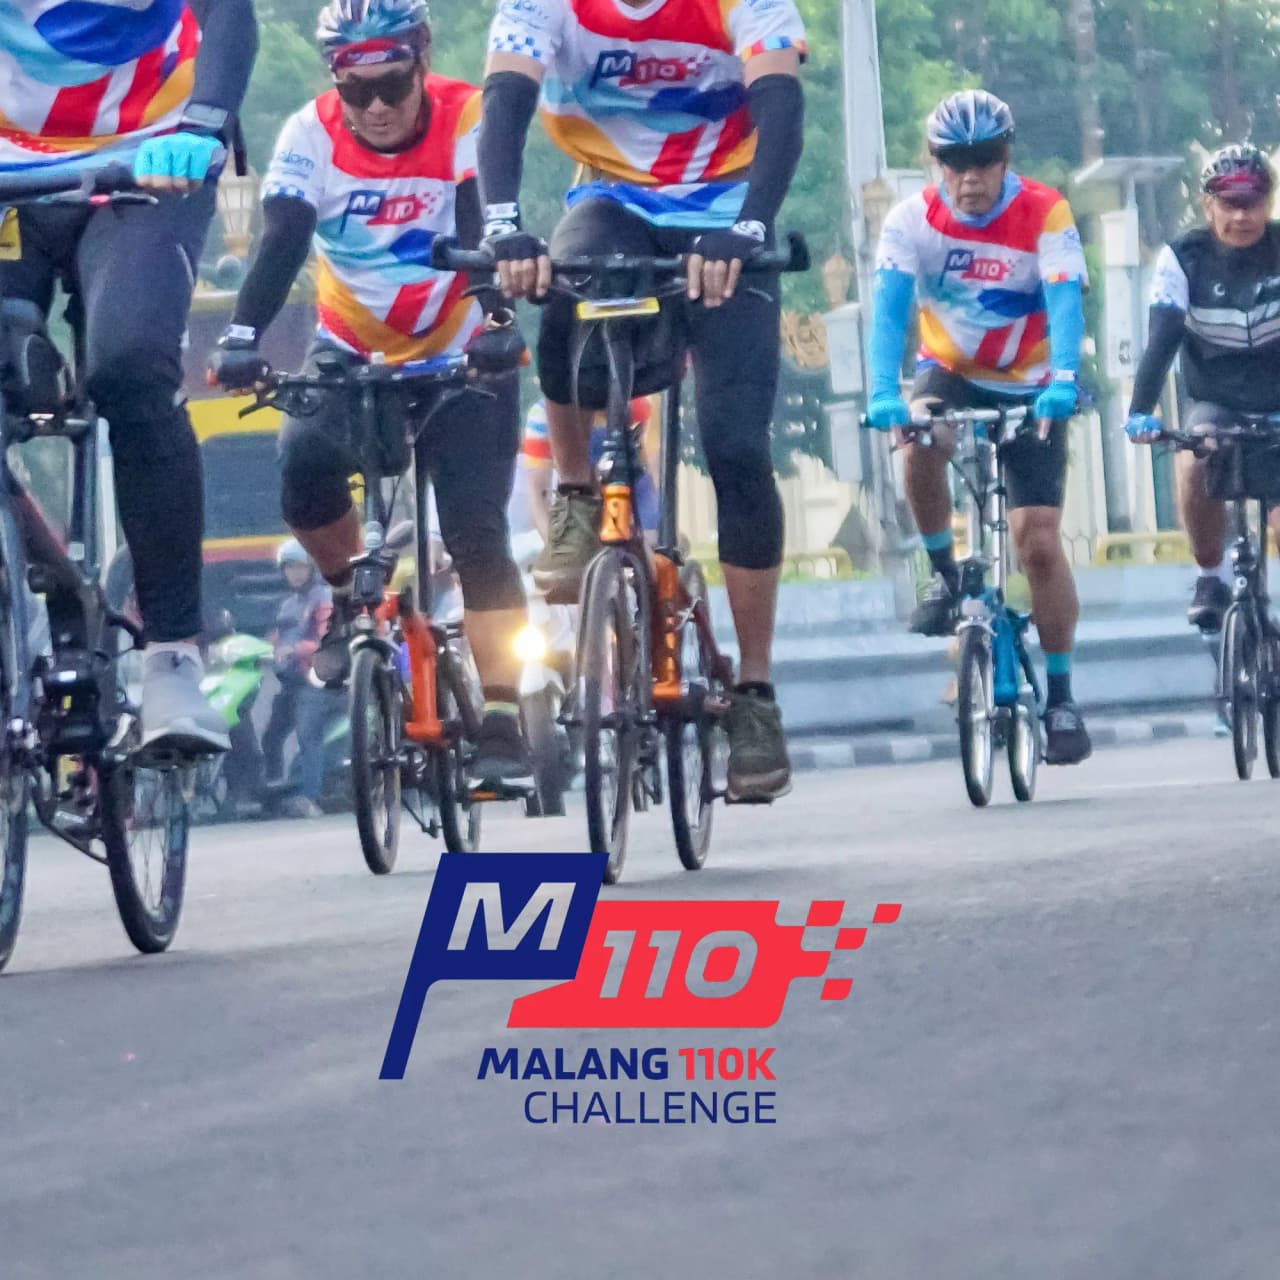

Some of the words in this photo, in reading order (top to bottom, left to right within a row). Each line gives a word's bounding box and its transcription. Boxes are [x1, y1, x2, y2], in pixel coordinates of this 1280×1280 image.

[601, 55, 632, 73] M
[639, 62, 676, 80] 110
[973, 261, 1000, 277] 110
